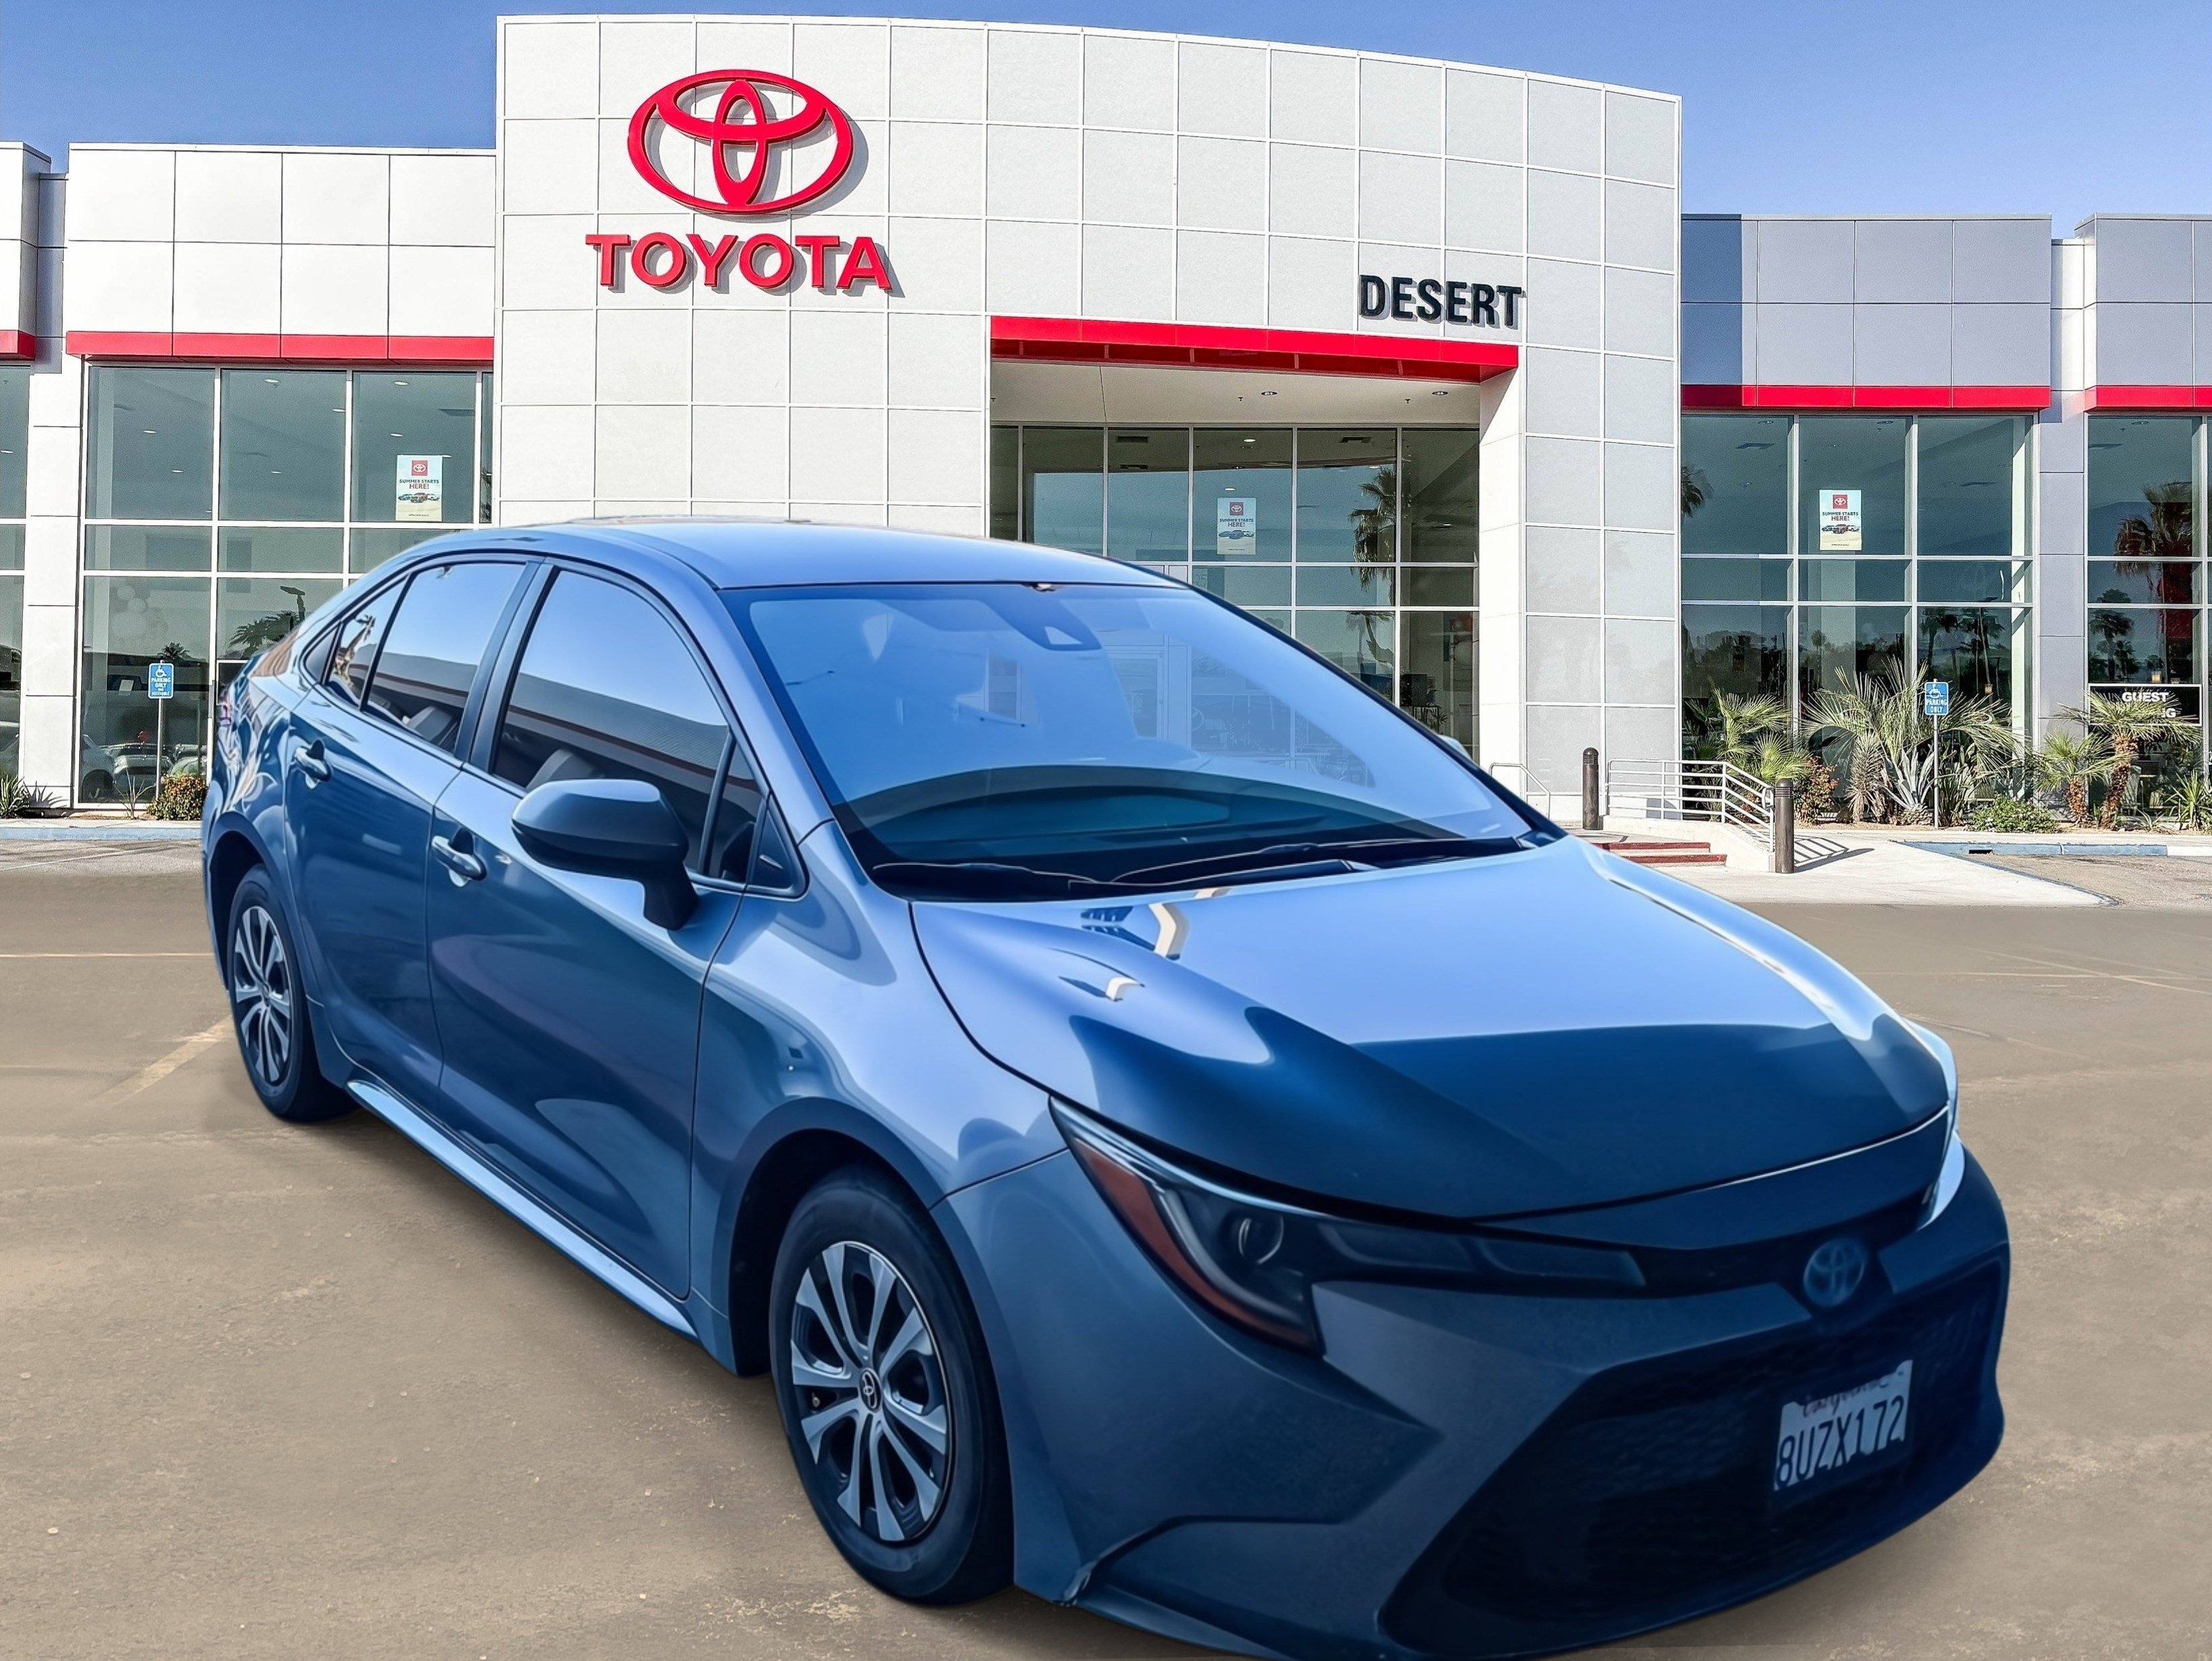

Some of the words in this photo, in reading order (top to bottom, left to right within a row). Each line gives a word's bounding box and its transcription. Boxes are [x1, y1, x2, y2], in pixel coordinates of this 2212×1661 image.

[585, 232, 893, 291] TOYOTA
[1359, 274, 1522, 326] DESERT
[2121, 691, 2169, 703] GUEST
[1775, 1395, 1905, 1487] 8UZX172
